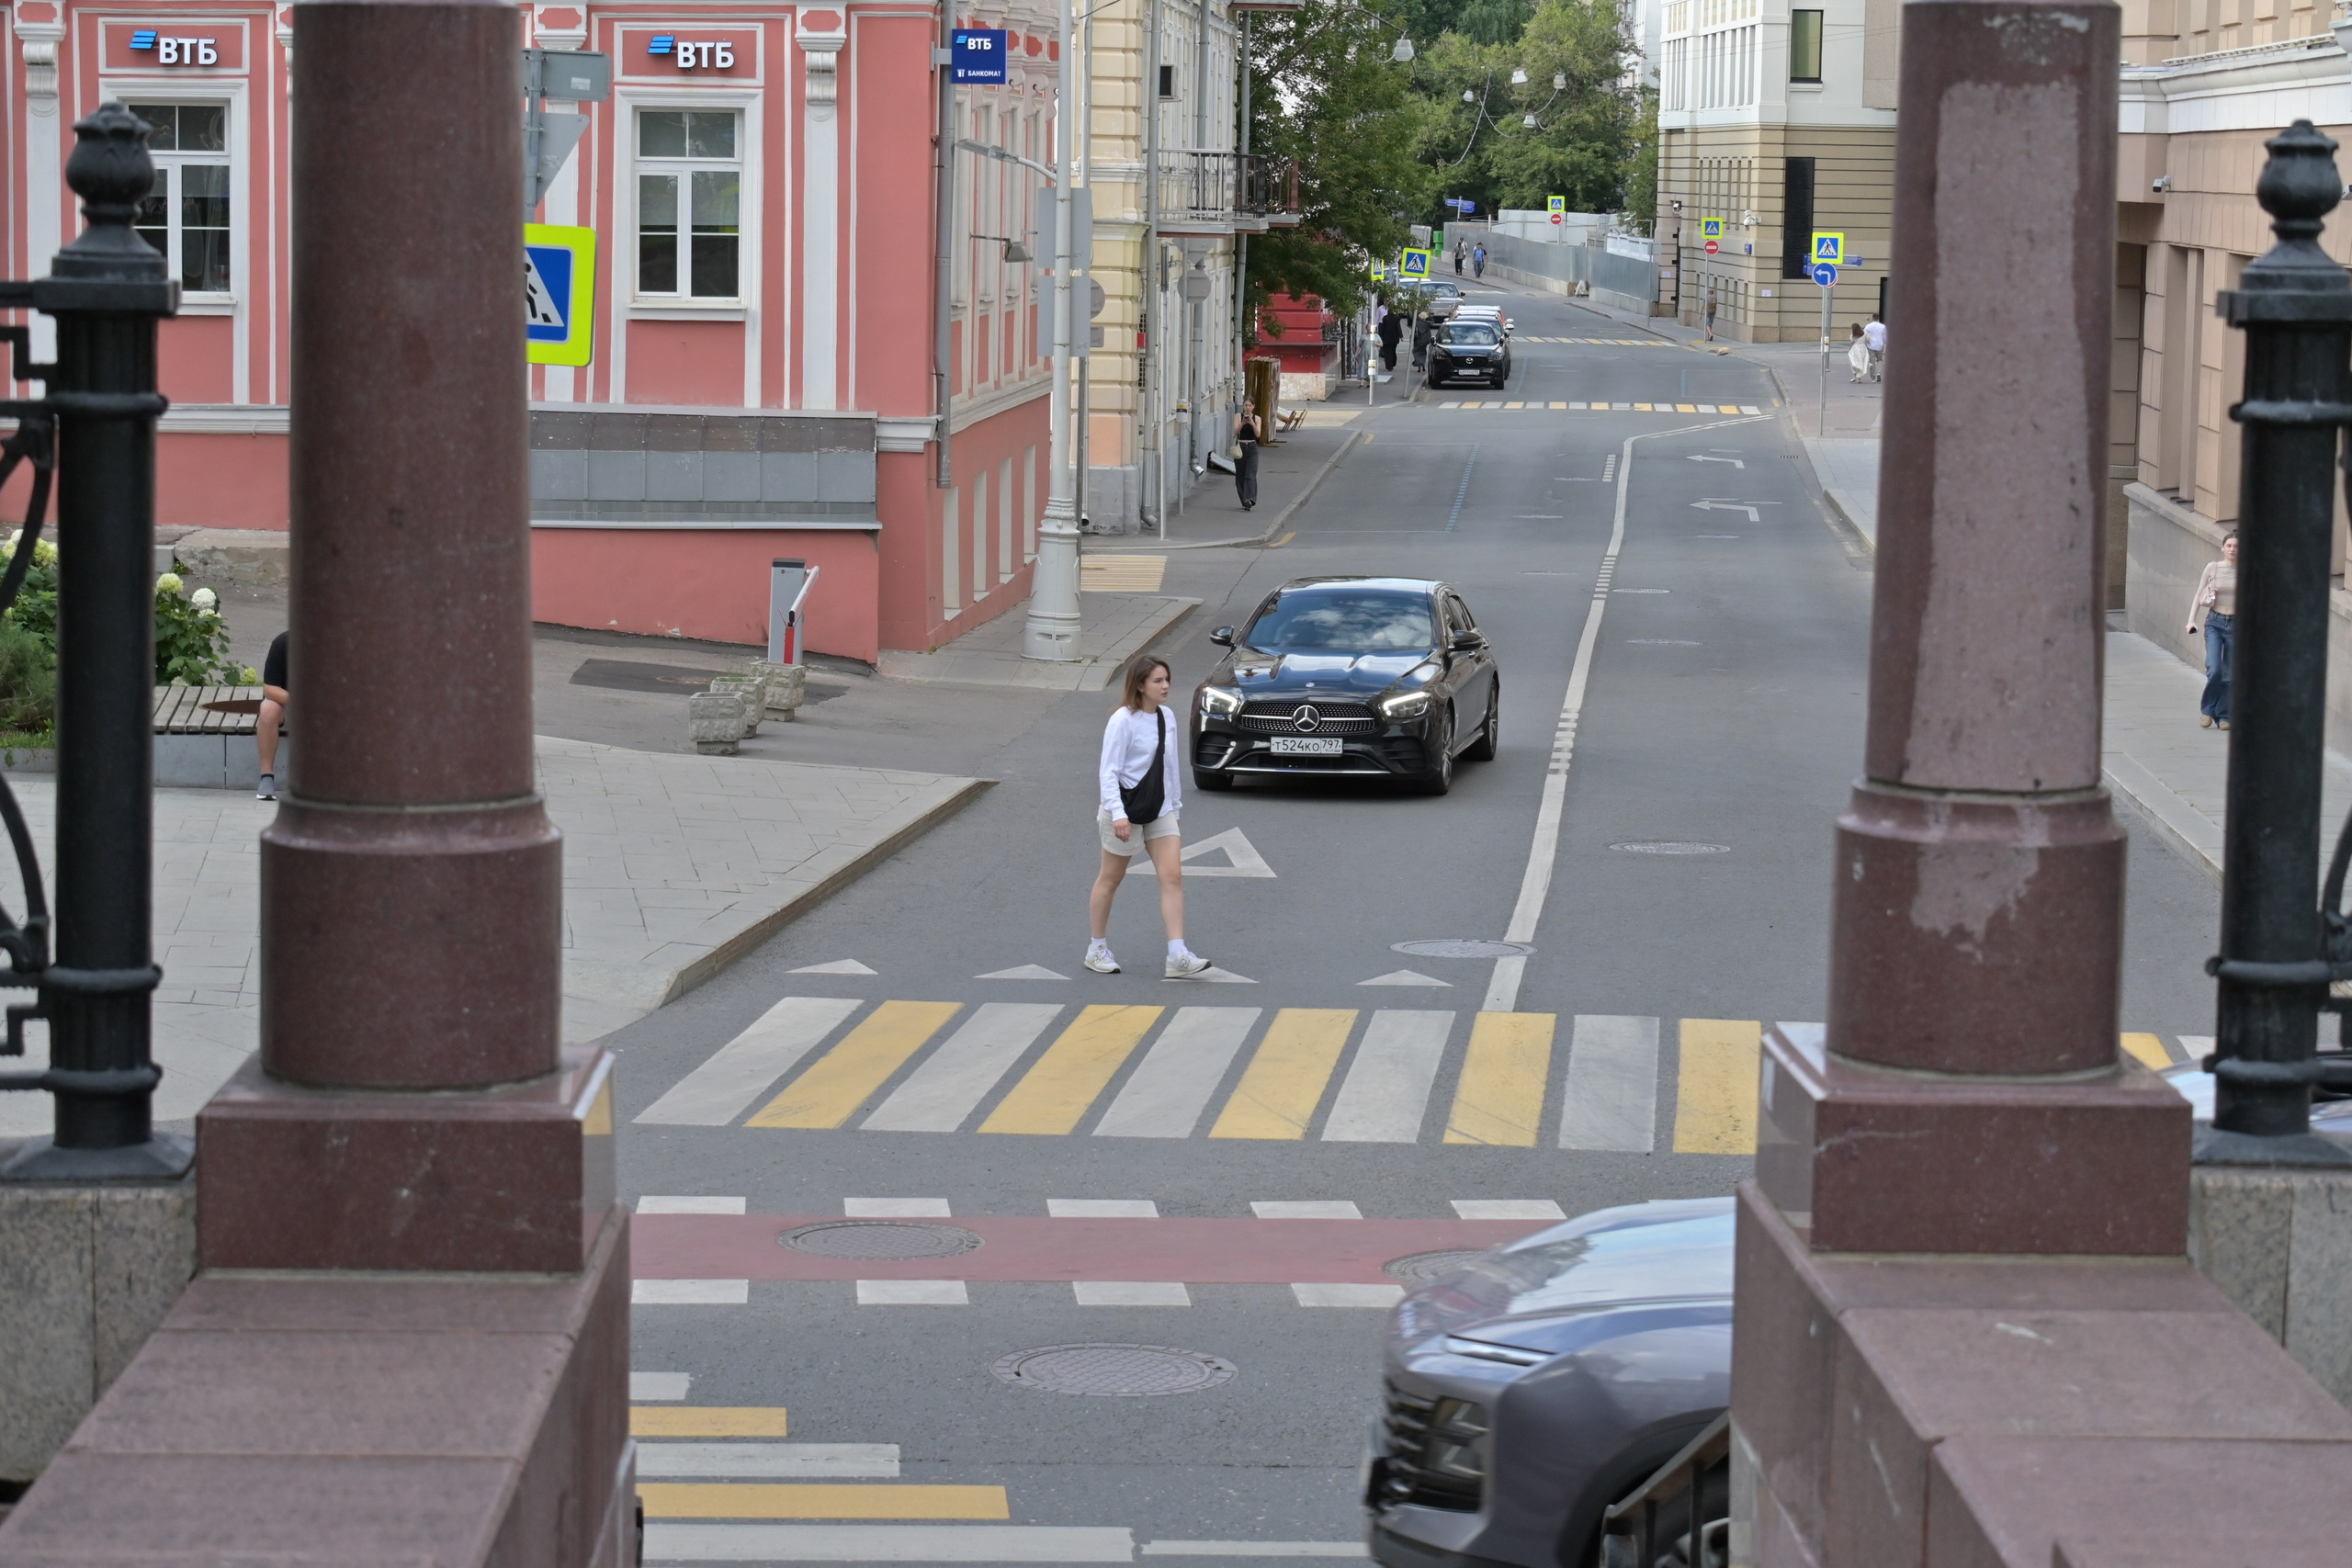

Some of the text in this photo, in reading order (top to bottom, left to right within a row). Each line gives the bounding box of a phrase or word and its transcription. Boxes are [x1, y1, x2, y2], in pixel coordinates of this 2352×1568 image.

[159, 38, 218, 64] ВТБ
[967, 38, 991, 50] ВТБ
[677, 42, 735, 68] ВТБ
[1321, 739, 1340, 748] 797
